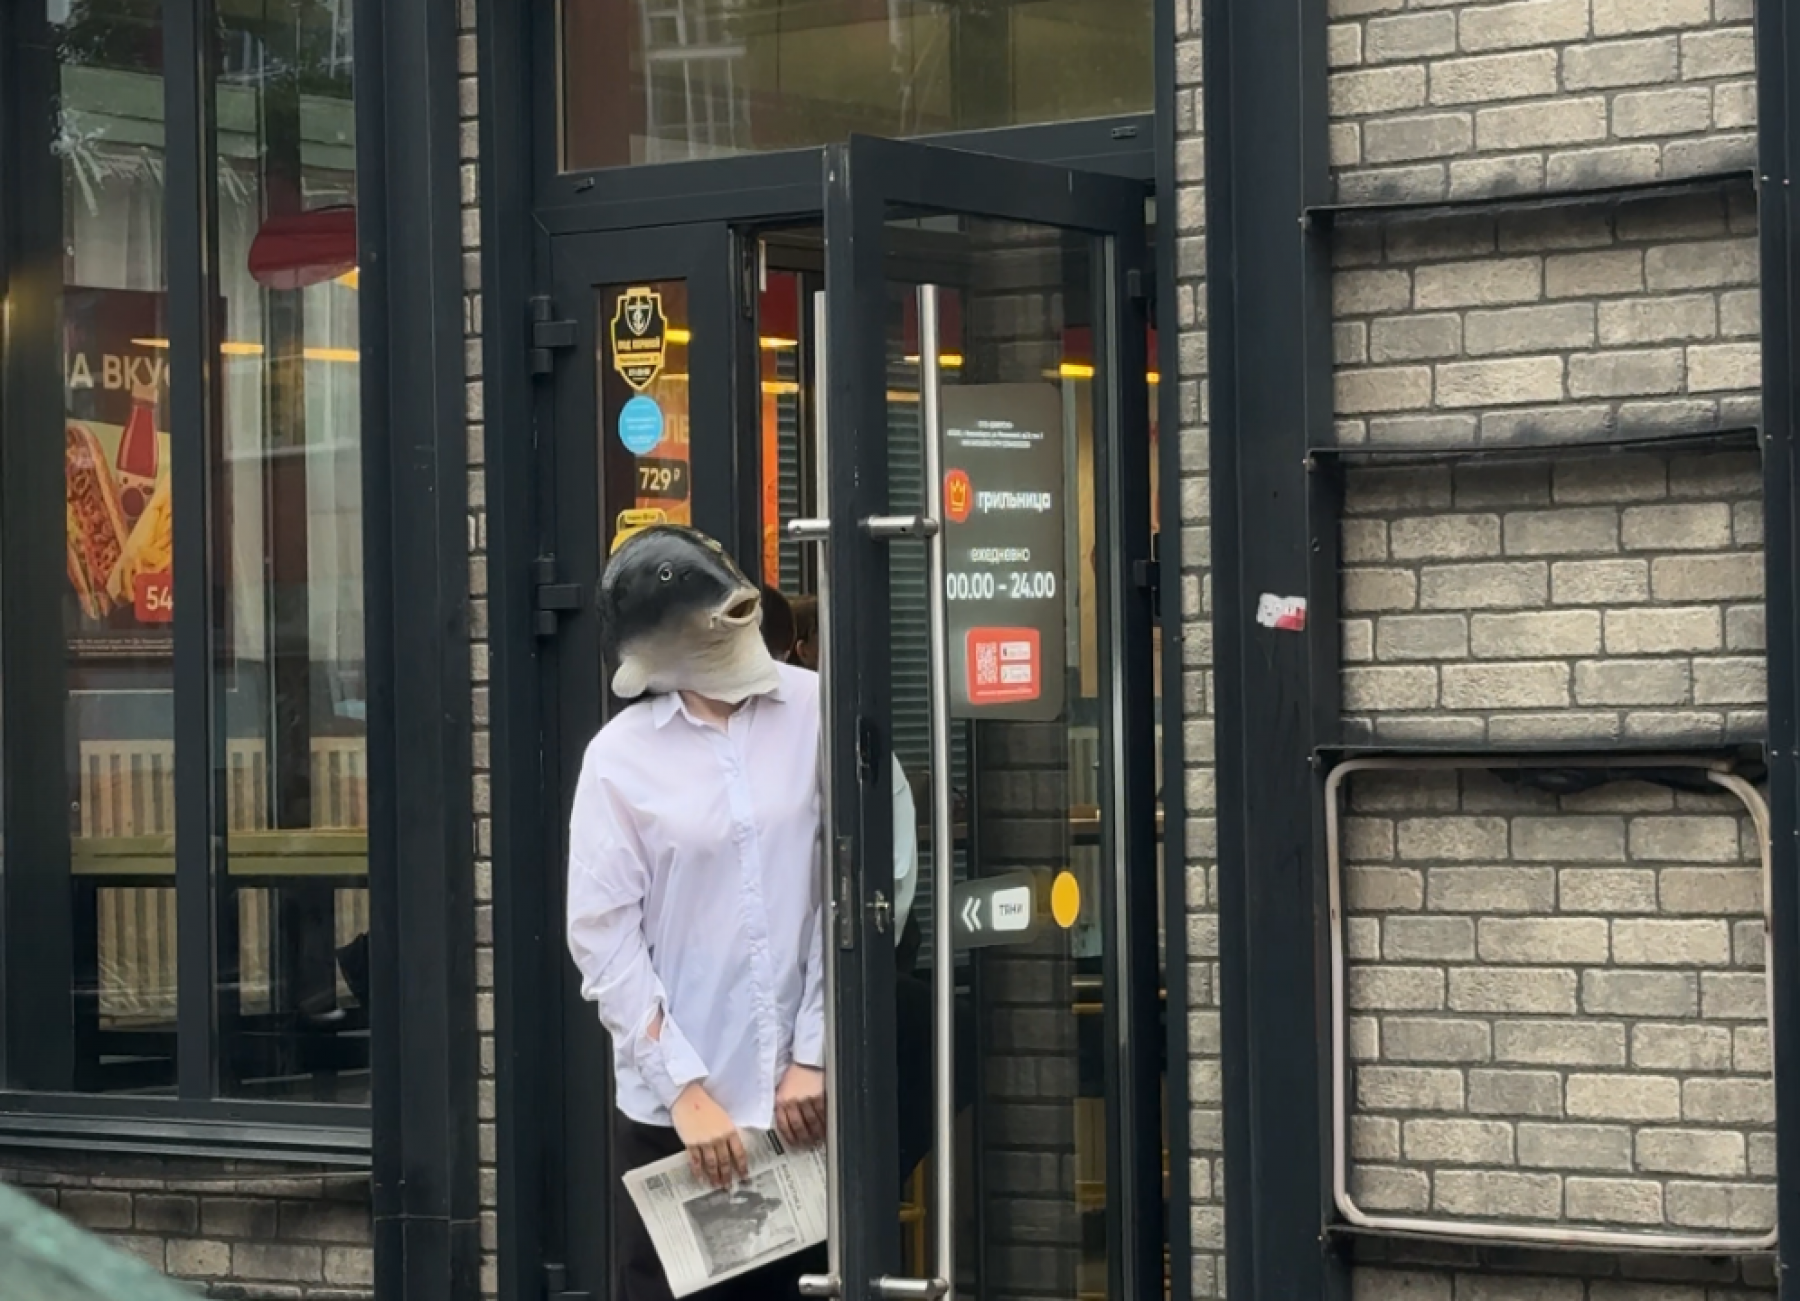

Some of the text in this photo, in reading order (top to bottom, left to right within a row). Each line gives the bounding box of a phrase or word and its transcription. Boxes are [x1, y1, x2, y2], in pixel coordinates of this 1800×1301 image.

[65, 351, 170, 391] А ВКУ
[977, 491, 1051, 514] грильница
[970, 547, 1030, 565] ежедневно
[946, 572, 995, 600] 00.00
[1010, 571, 1056, 599] 24.00
